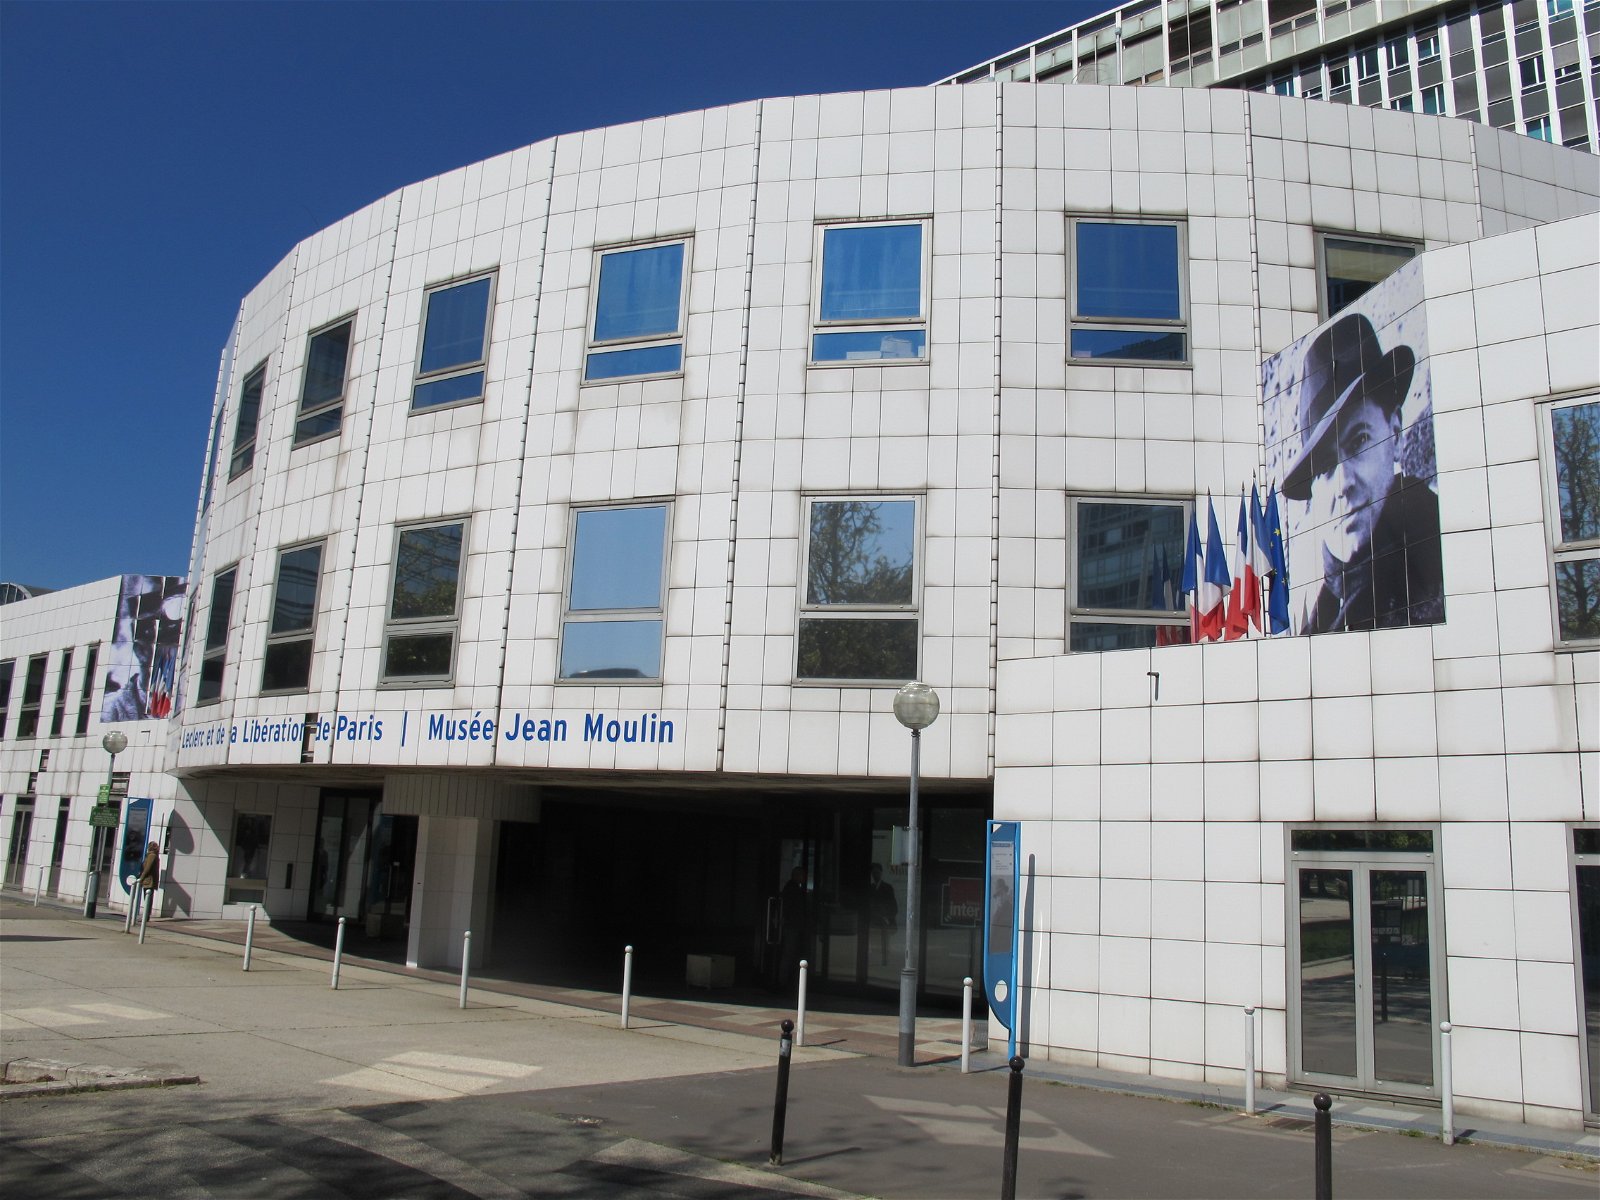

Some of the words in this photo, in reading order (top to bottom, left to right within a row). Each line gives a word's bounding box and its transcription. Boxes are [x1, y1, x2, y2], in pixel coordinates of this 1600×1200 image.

[182, 727, 204, 748] Leclerc
[206, 724, 215, 746] et
[216, 722, 225, 744] de
[336, 714, 383, 741] Paris
[428, 711, 494, 741] Musée
[505, 713, 567, 742] Jean
[583, 712, 674, 743] Moulin
